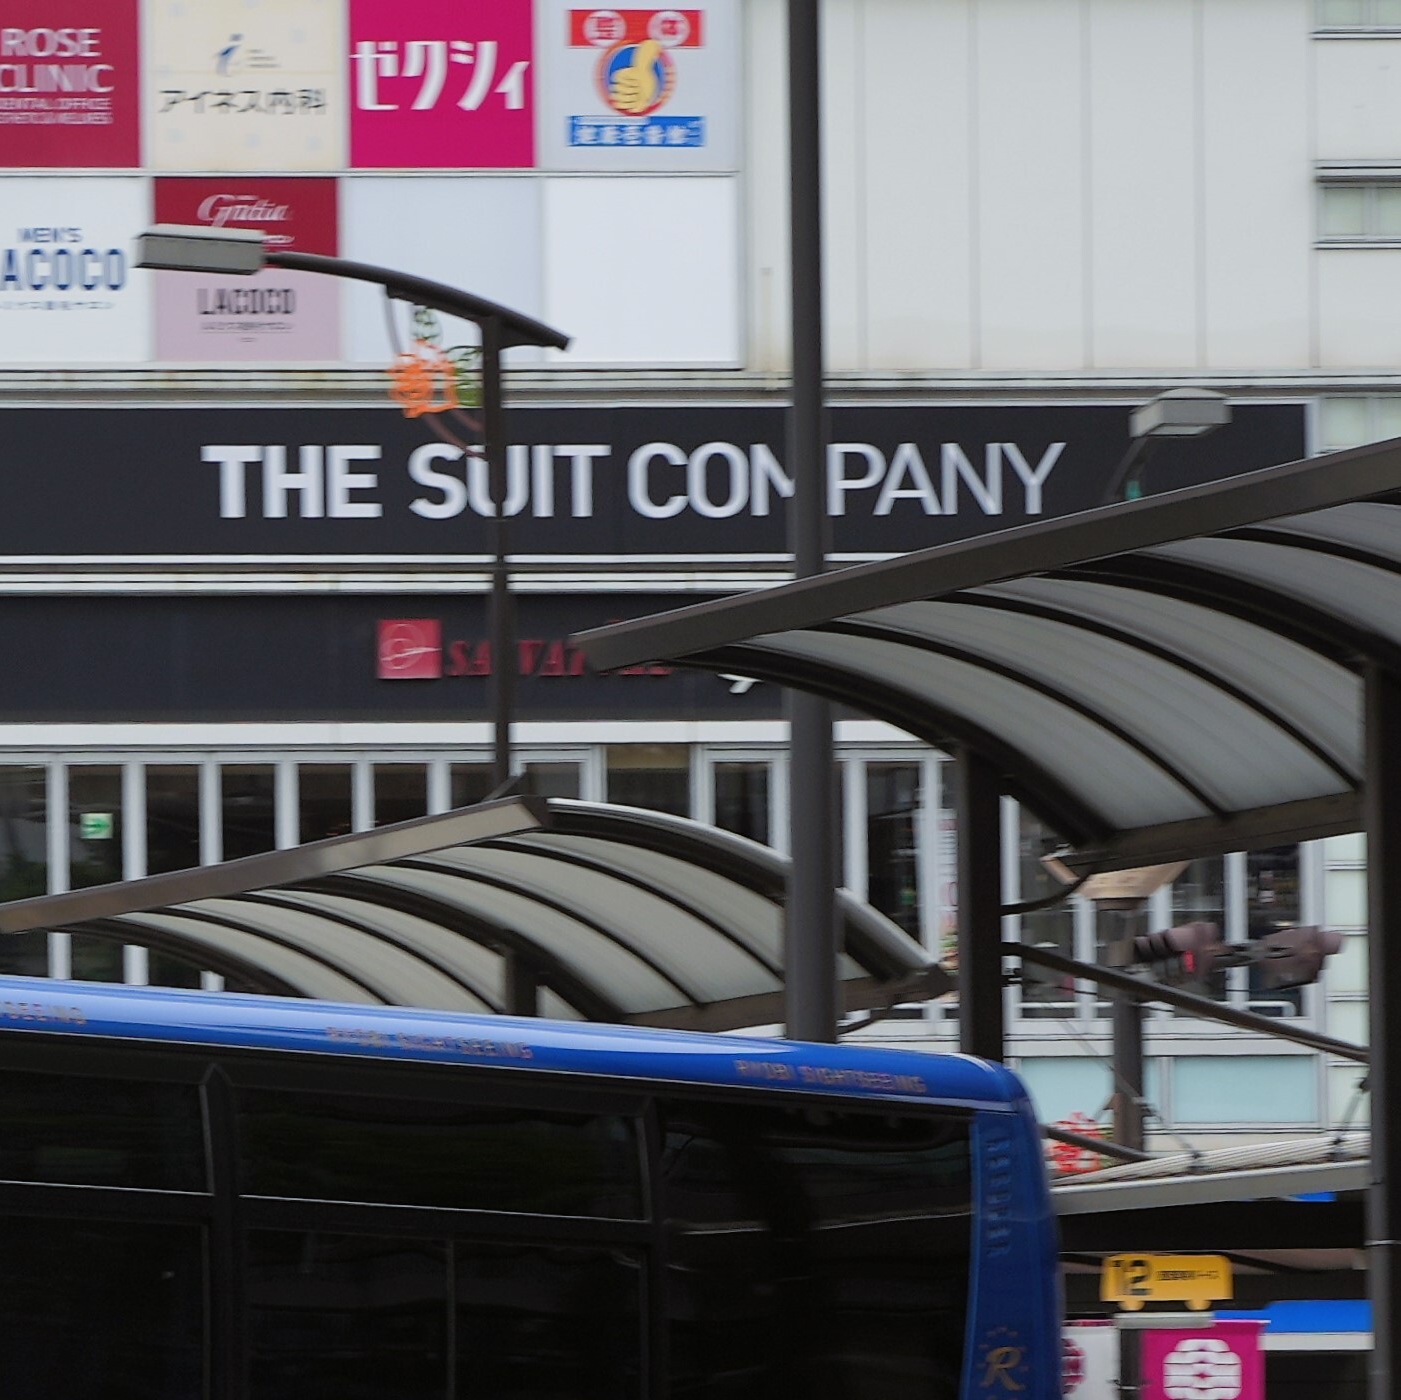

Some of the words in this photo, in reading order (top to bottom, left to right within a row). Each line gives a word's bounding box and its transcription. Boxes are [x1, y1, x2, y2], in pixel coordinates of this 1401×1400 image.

[0, 28, 101, 57] ROSE
[348, 40, 531, 111] ゼクシィ
[197, 288, 296, 314] LACOCO
[201, 444, 382, 518] THE
[408, 441, 611, 520] SUIT
